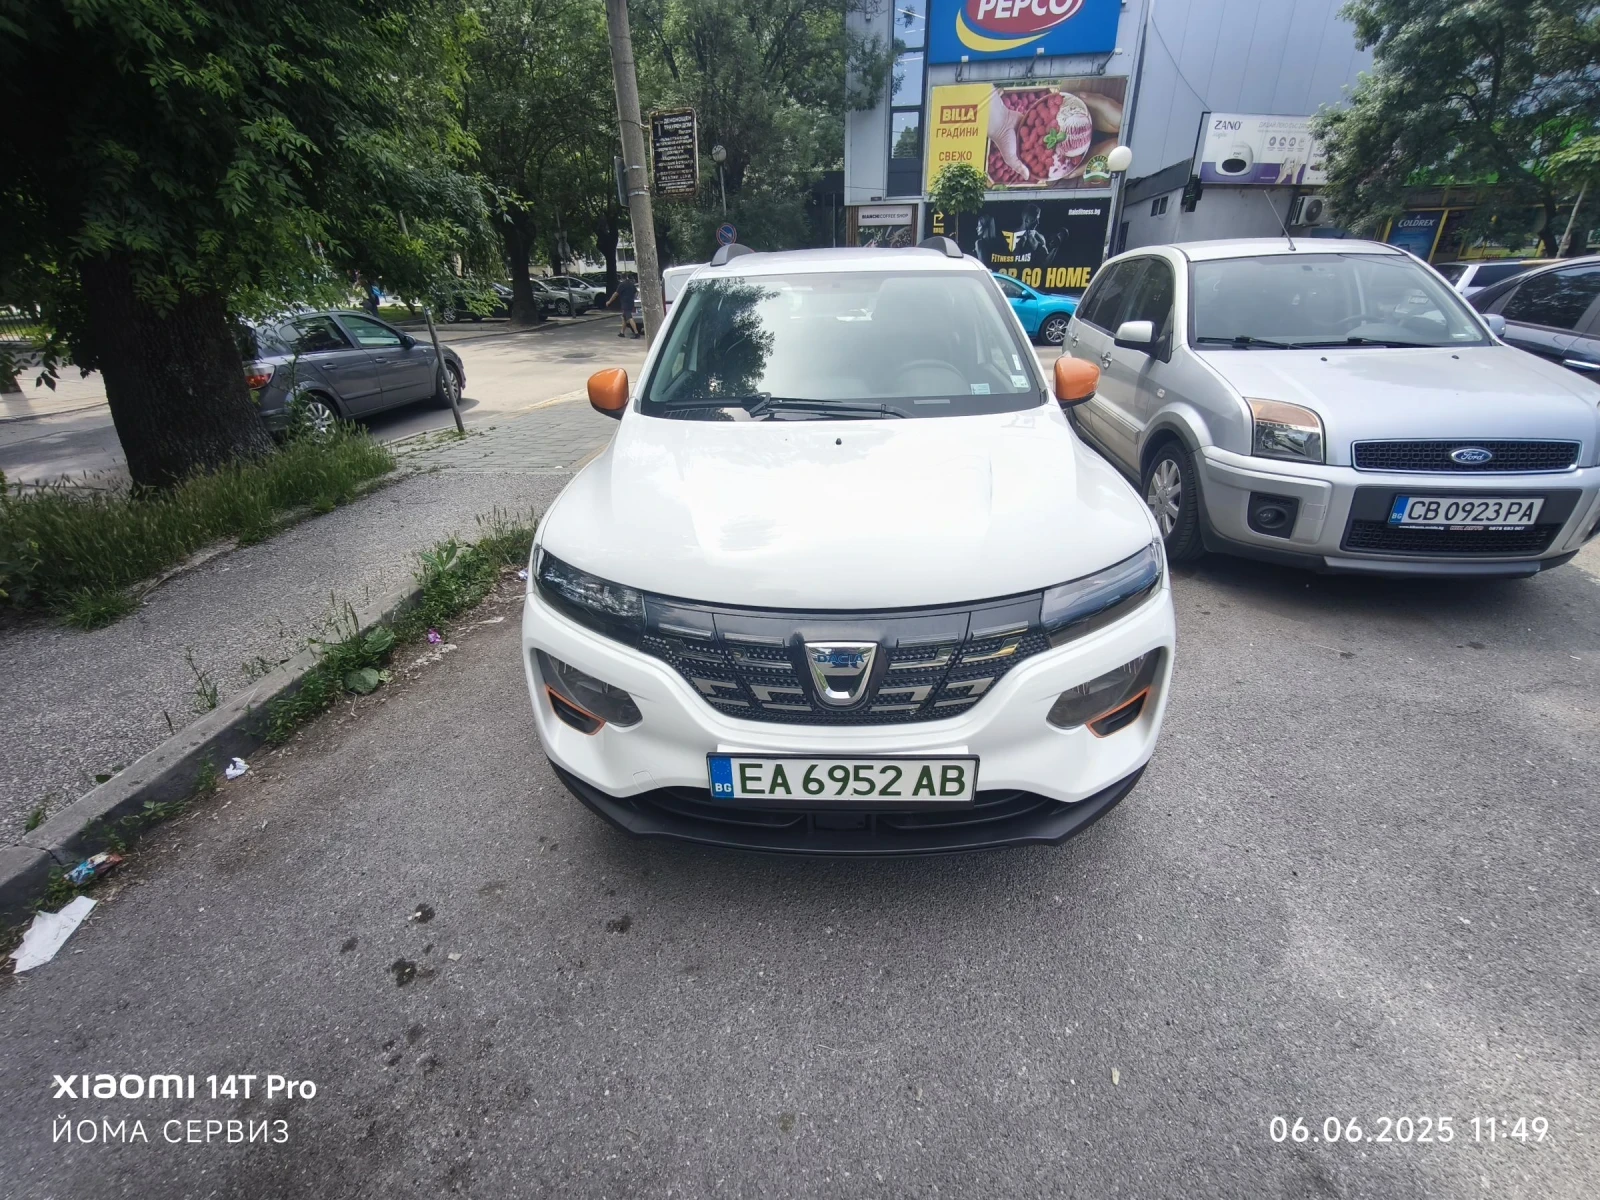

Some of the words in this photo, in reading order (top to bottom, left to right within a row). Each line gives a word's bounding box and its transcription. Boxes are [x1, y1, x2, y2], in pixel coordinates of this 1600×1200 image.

[977, 0, 1073, 20] PEPCO
[942, 108, 975, 121] BILLA
[1214, 120, 1241, 130] ZANO
[936, 127, 978, 139] ГРАДИНИ
[938, 151, 972, 161] СВЕЖО
[1398, 219, 1435, 227] COLDREX
[991, 253, 1014, 262] FITNESS
[1022, 267, 1042, 288] GO
[1045, 267, 1092, 288] HOME
[1461, 451, 1485, 460] Ford
[1408, 501, 1441, 520] CB
[1444, 501, 1503, 521] 0923
[1503, 502, 1535, 522] PA
[816, 654, 865, 663] DACIA
[715, 783, 731, 793] BG
[739, 763, 792, 795] EA
[802, 764, 902, 796] 6952
[912, 765, 966, 796] AB
